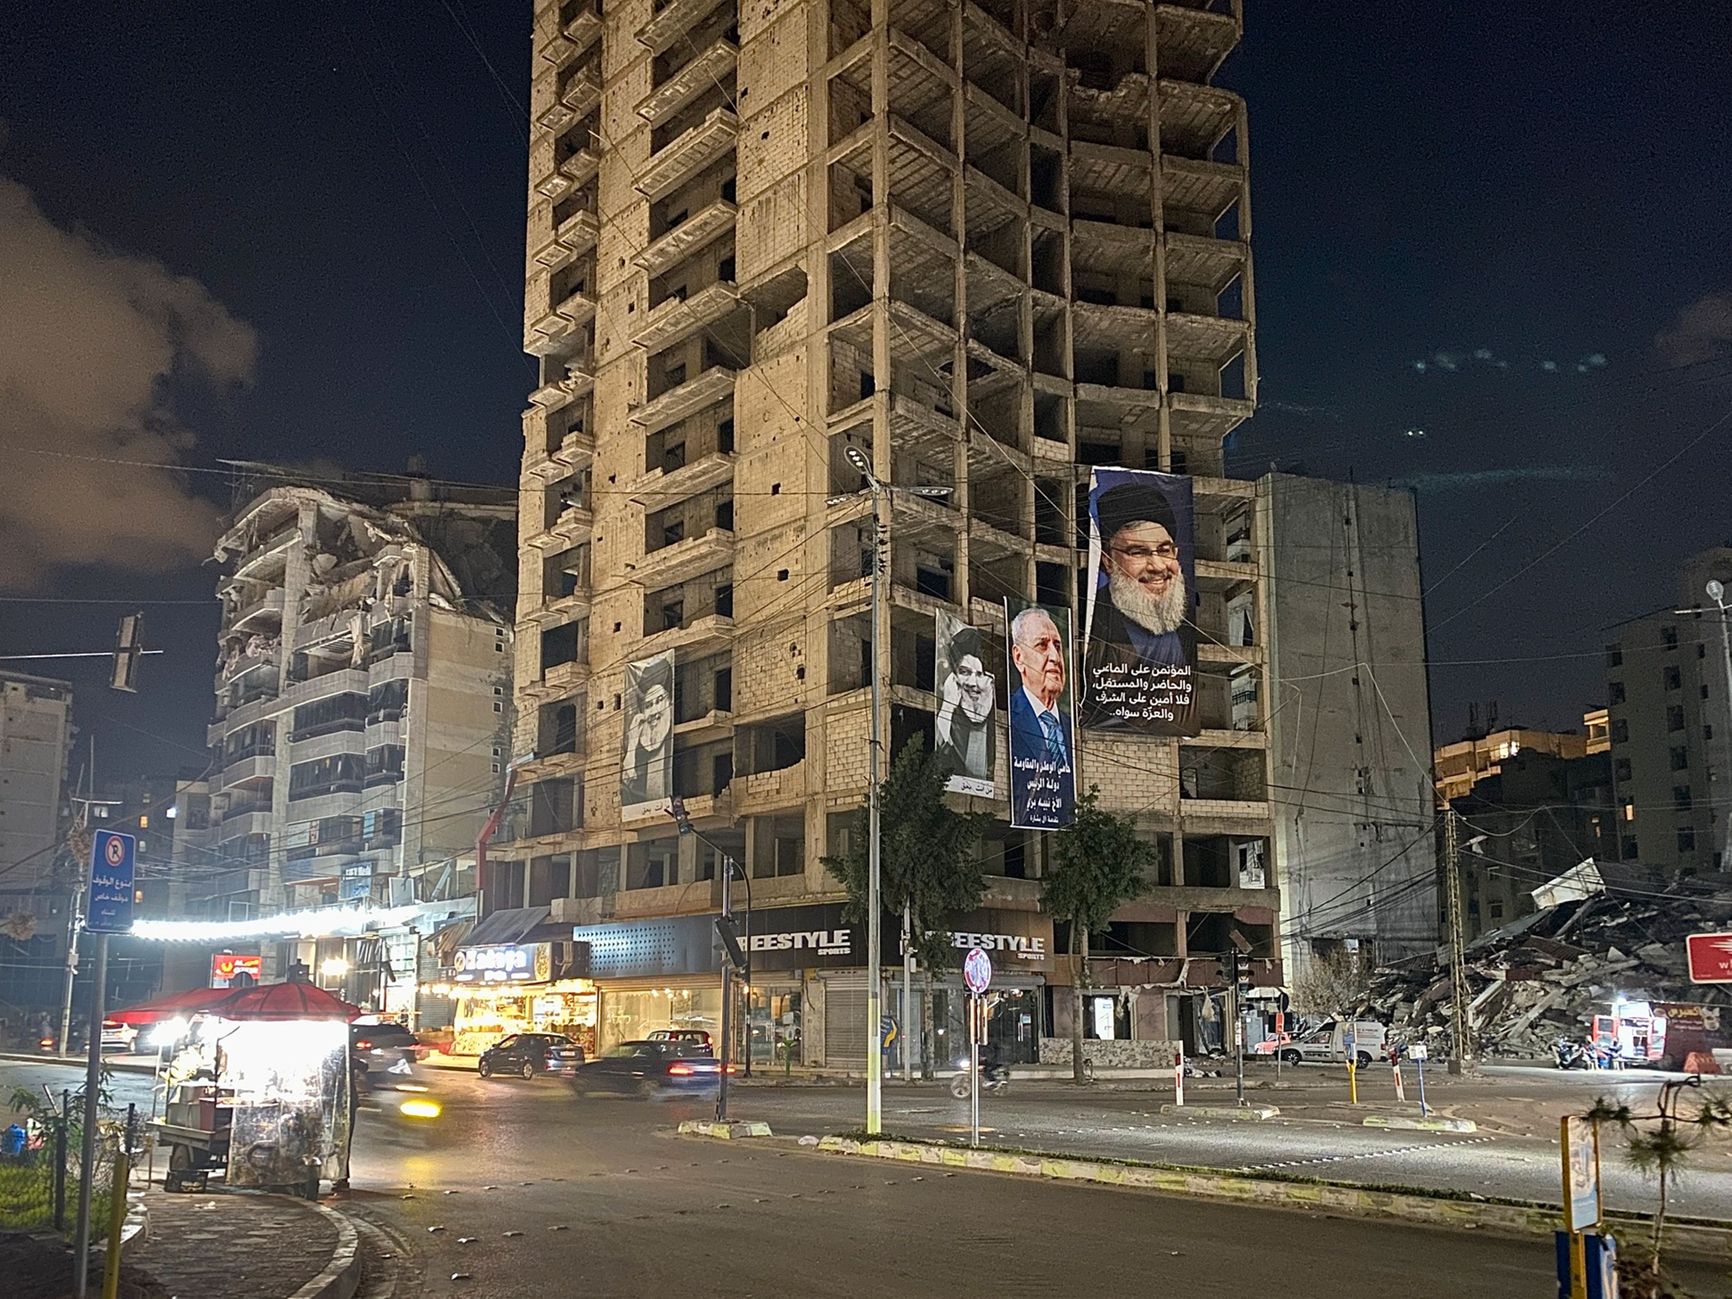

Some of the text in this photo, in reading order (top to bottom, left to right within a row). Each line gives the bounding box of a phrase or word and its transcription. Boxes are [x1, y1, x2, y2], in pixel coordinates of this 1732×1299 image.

[1092, 663, 1191, 677] المؤتمن على الماضي
[1150, 679, 1192, 692] والحاضر
[1095, 690, 1190, 706] فلا أمين على الشرف
[1026, 777, 1060, 792] دولة الرئيس
[1037, 797, 1051, 811] نبيه
[92, 874, 114, 887] الوقوف
[736, 929, 851, 951] REESTYLE
[817, 947, 851, 955] SPORTS
[1016, 952, 1045, 961] SPORTS
